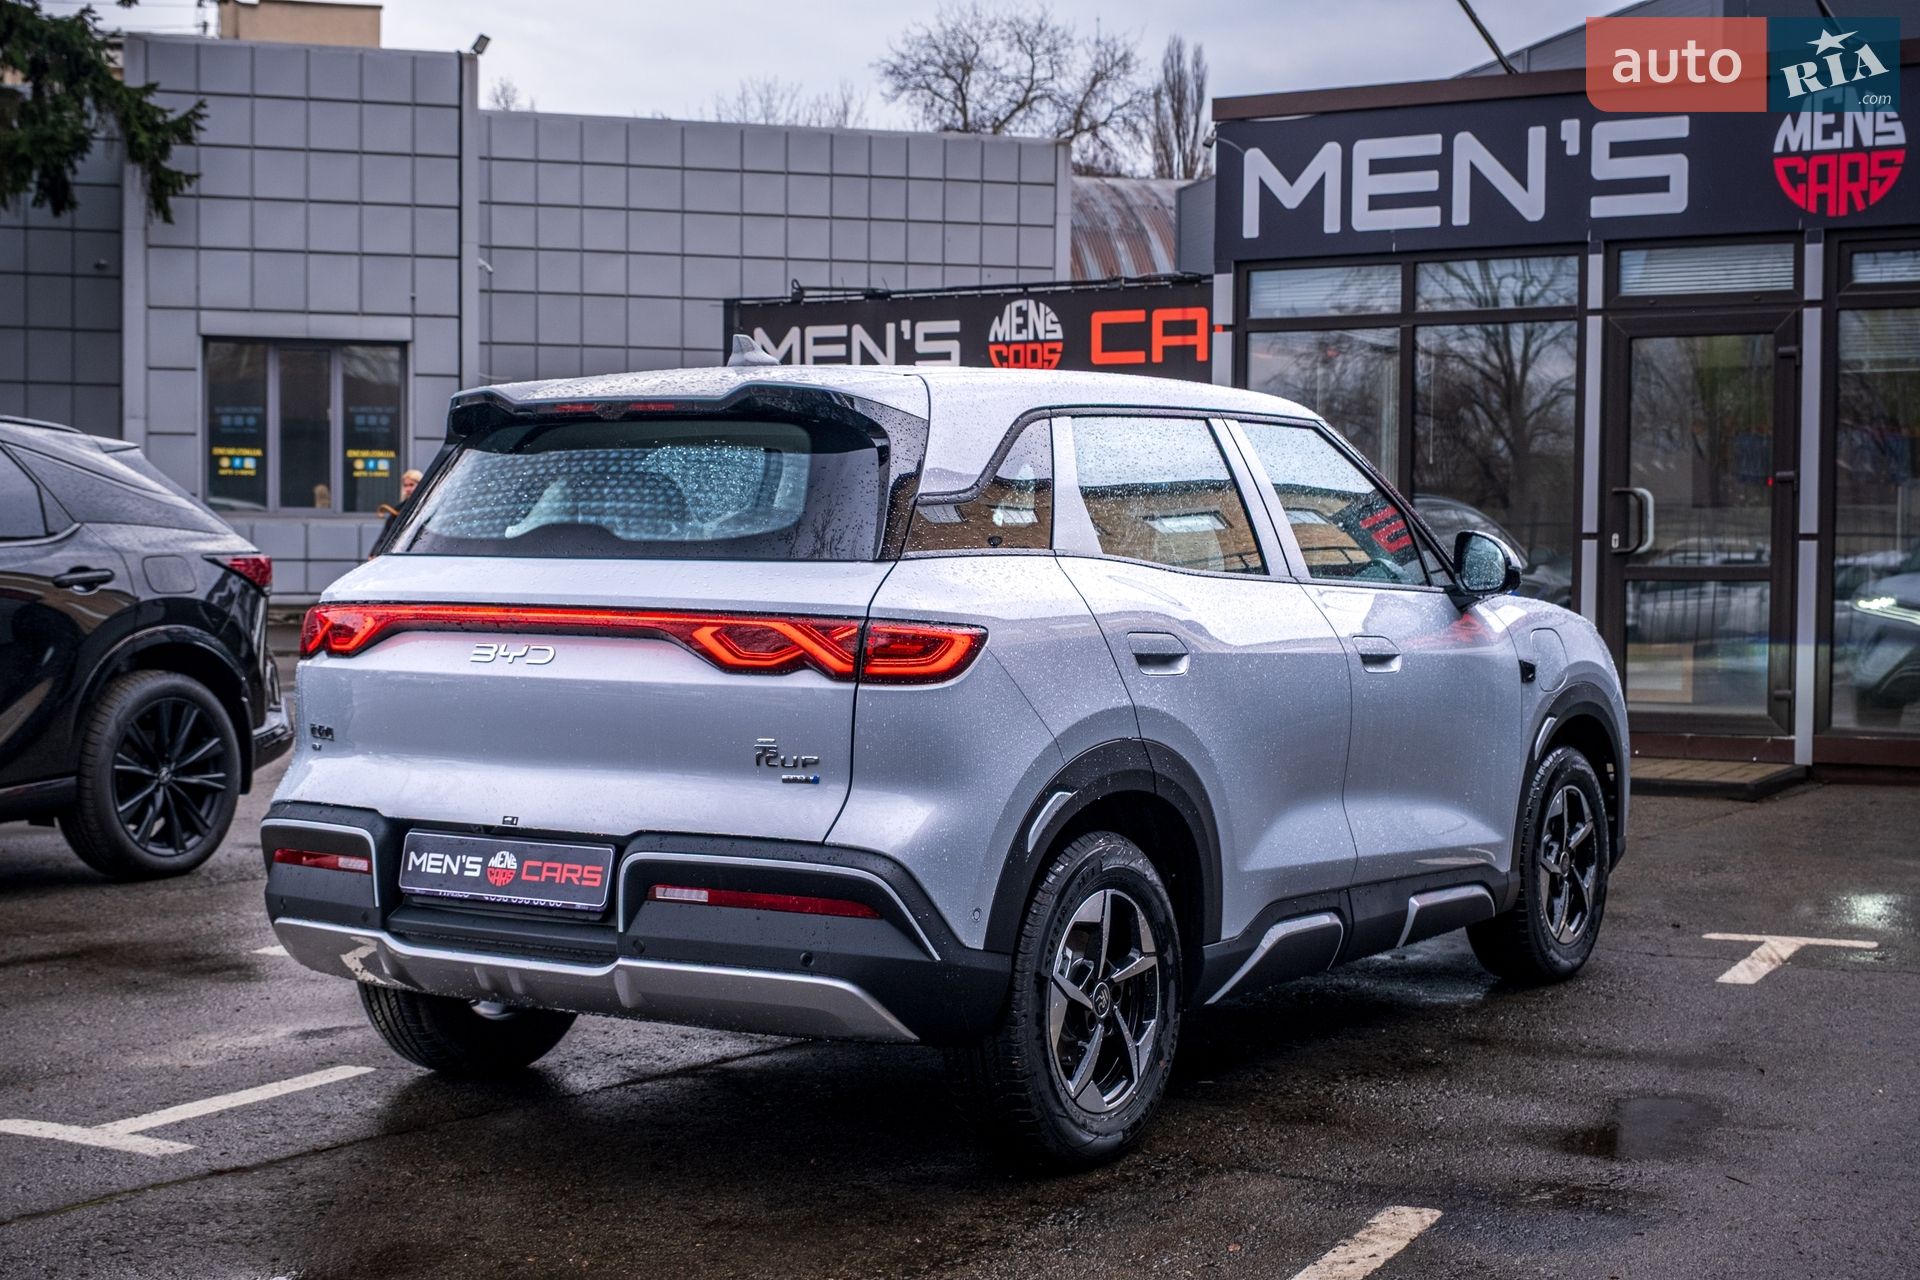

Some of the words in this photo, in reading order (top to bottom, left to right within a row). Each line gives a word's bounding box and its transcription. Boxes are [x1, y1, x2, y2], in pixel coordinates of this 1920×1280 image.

[1242, 115, 1690, 239] MEN'S
[1772, 149, 1906, 217] CARS
[753, 319, 961, 366] MEN'S
[1090, 307, 1209, 365] CA
[470, 643, 556, 665] BYD
[407, 851, 483, 877] MEN'S
[521, 860, 604, 887] CARS
